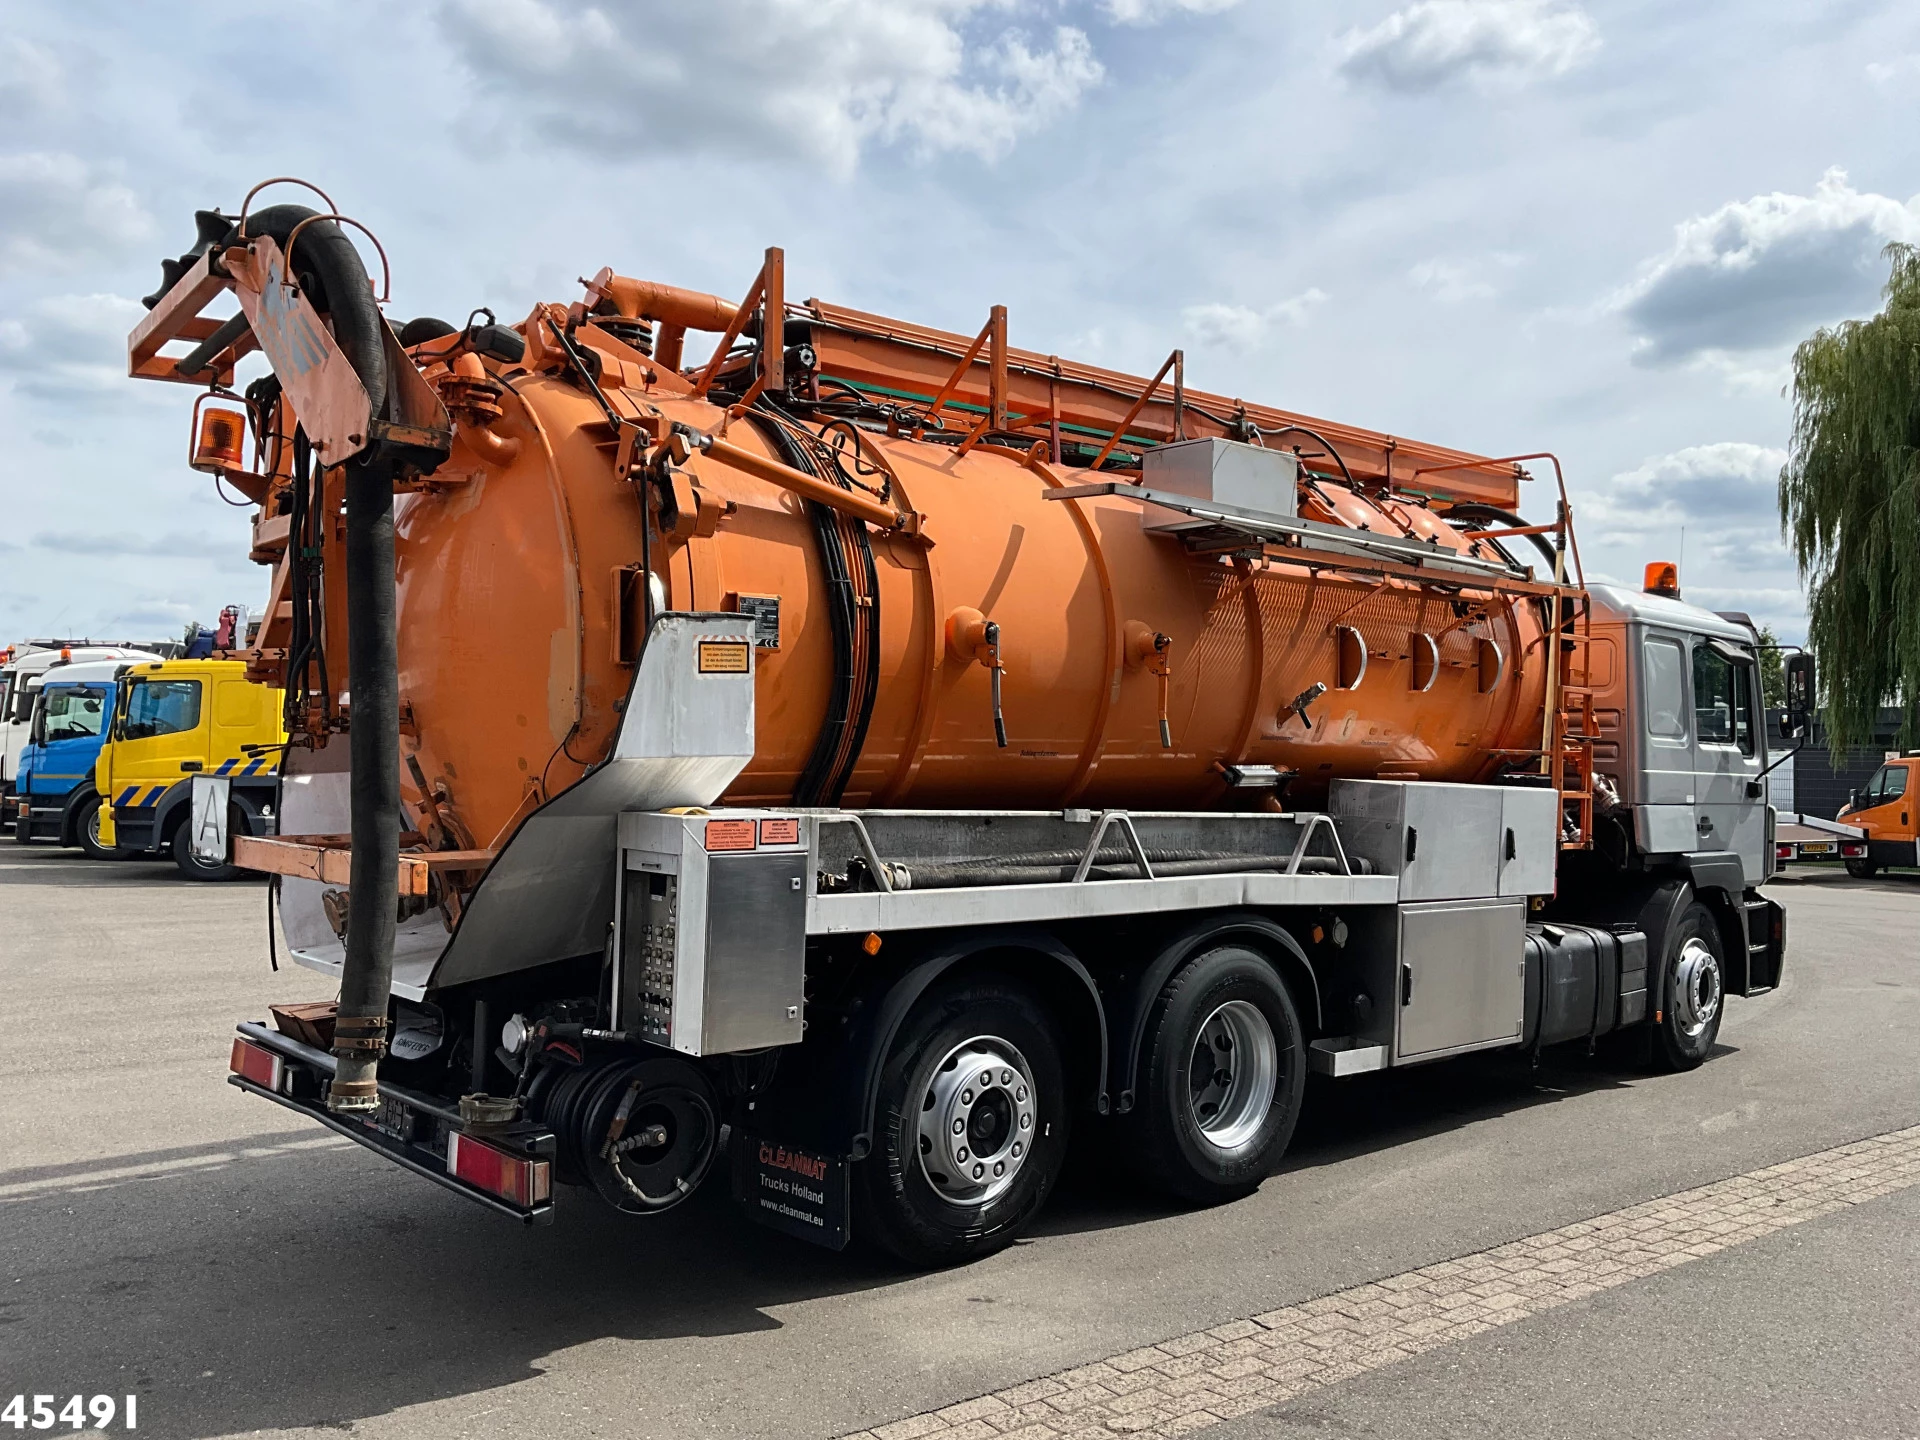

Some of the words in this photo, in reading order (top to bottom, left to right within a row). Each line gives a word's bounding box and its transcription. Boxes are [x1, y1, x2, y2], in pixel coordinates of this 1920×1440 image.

[200, 784, 221, 845] A
[759, 1145, 827, 1181] CLEANMAT
[759, 1173, 790, 1193] Trucks
[791, 1182, 824, 1204] Holland
[760, 1197, 824, 1226] www.cleanmat.eu
